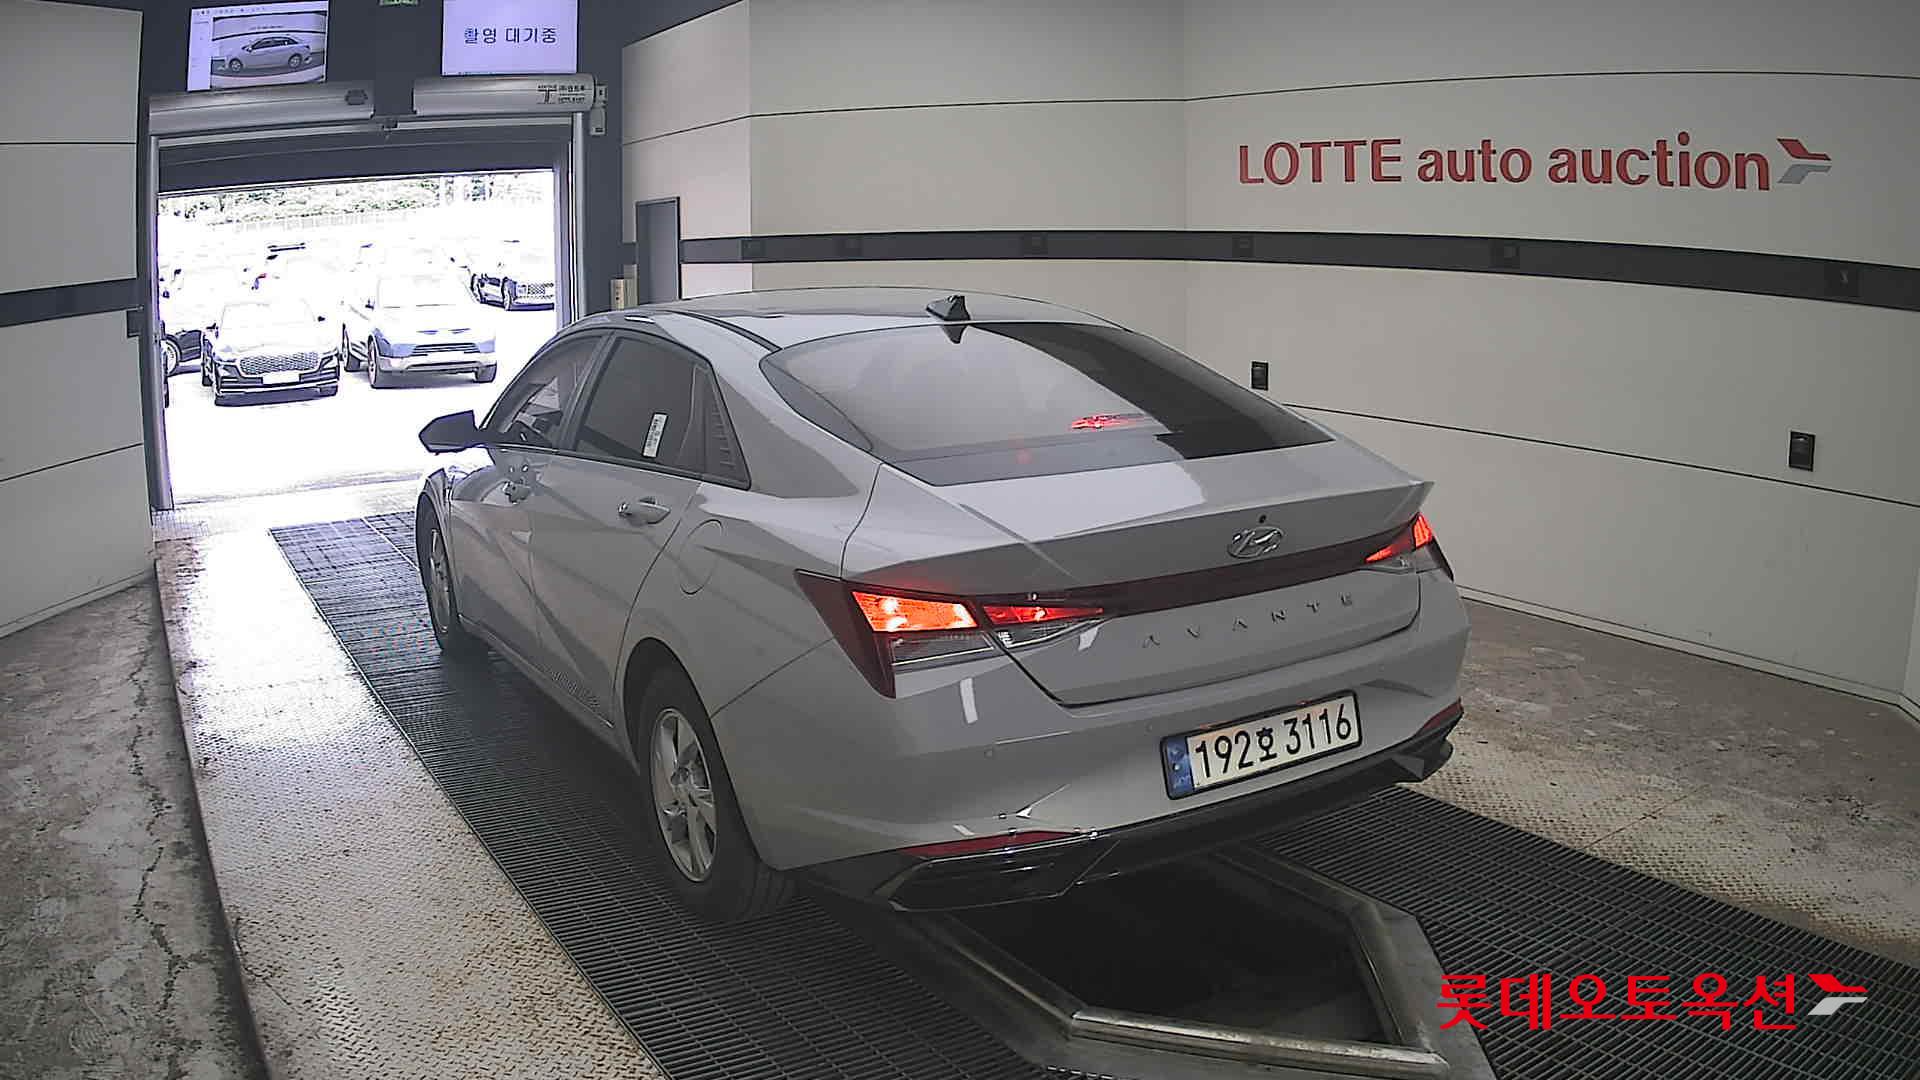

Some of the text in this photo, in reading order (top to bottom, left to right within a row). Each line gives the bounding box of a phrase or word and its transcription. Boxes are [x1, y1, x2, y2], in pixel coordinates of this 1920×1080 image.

[464, 27, 556, 44] 촬영 대기중
[1239, 132, 1770, 190] LOTTE auto auction
[1142, 592, 1353, 648] AVANTE
[1195, 703, 1352, 778] 192호 3116
